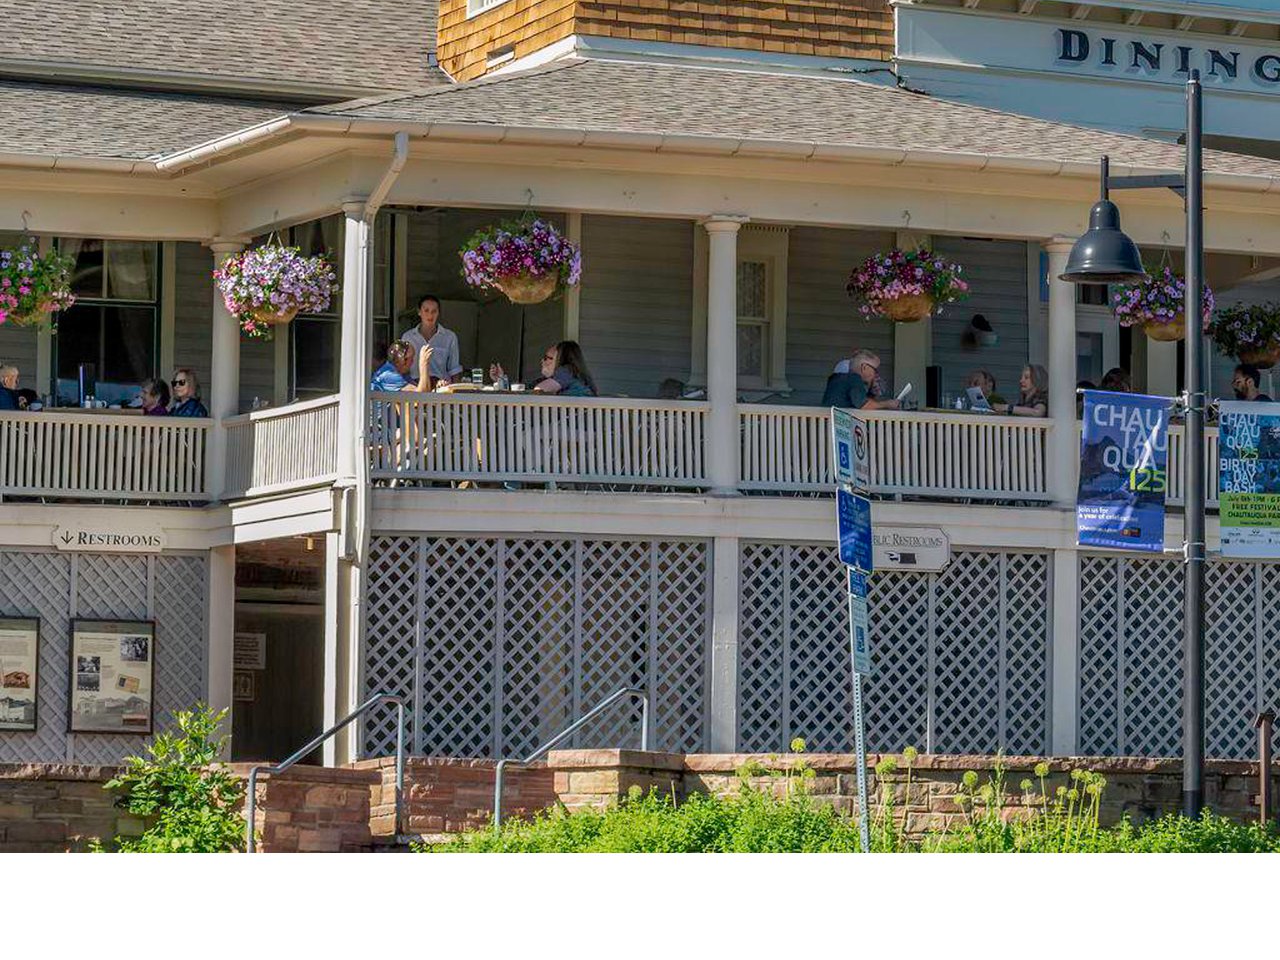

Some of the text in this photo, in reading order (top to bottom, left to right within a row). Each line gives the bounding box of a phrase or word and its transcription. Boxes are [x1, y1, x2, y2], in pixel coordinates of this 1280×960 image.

[1094, 403, 1163, 431] CHAU
[1220, 411, 1257, 427] CHAU
[1120, 426, 1167, 452] TAU
[1235, 424, 1260, 438] TAU
[1227, 435, 1254, 450] QUA
[1103, 441, 1158, 473] QUA
[1220, 458, 1256, 472] BIRTH
[1129, 468, 1166, 493] 125
[1233, 470, 1256, 483] DAY
[1225, 481, 1256, 494] BASH
[78, 531, 161, 547] RESTROOMS
